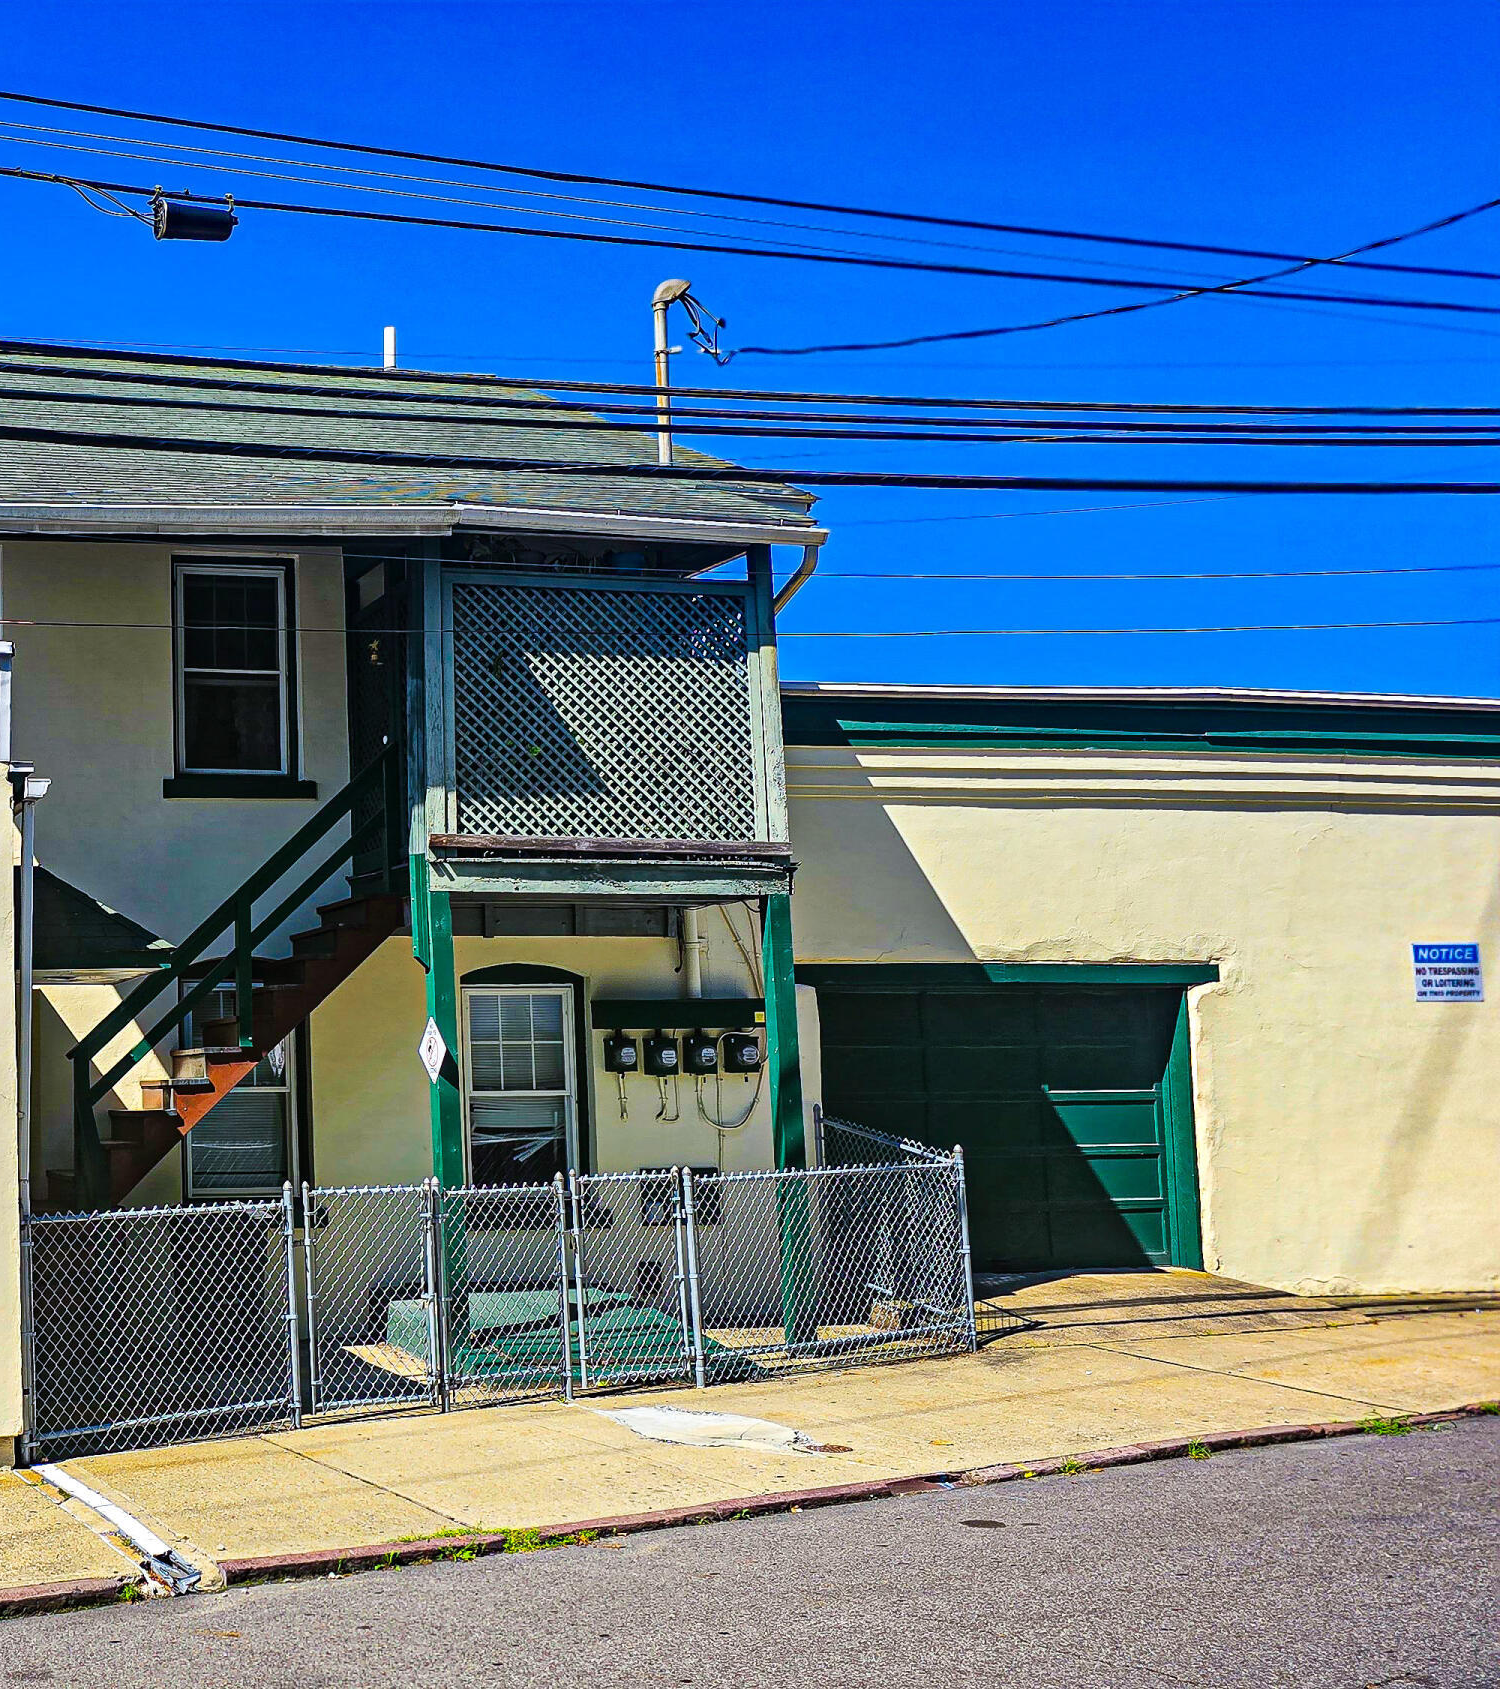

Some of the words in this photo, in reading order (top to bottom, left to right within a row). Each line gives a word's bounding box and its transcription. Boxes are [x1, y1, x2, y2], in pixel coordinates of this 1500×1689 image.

[1418, 948, 1473, 960] NOTICE
[1416, 967, 1427, 975] NO
[1428, 967, 1479, 975] TRESPASSING
[1422, 979, 1433, 987] OR
[1435, 979, 1475, 987] LOITERING
